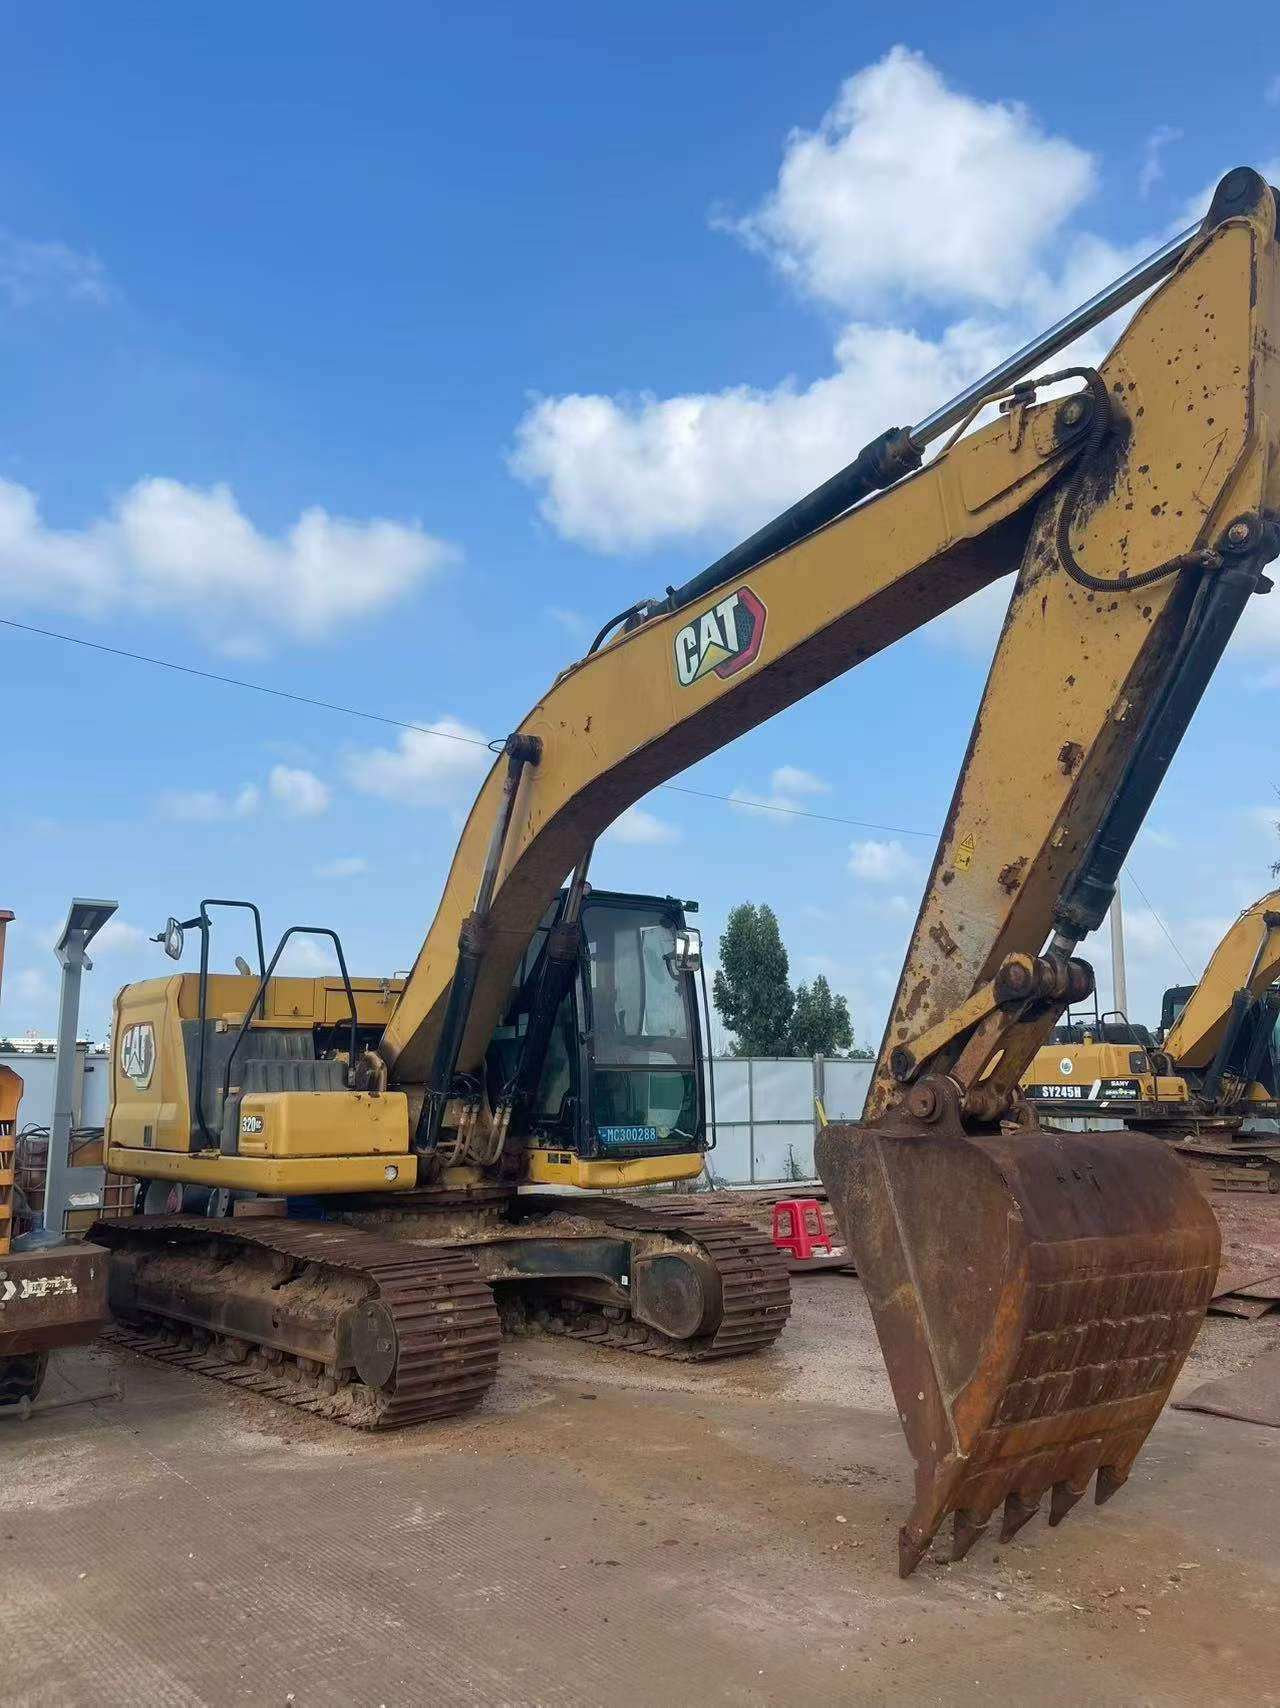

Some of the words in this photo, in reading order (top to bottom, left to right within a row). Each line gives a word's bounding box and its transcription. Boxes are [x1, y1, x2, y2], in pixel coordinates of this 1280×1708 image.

[675, 592, 739, 685] CAT
[121, 1025, 151, 1078] CAT
[1042, 1086, 1081, 1098] SY245H
[242, 1116, 256, 1132] 320
